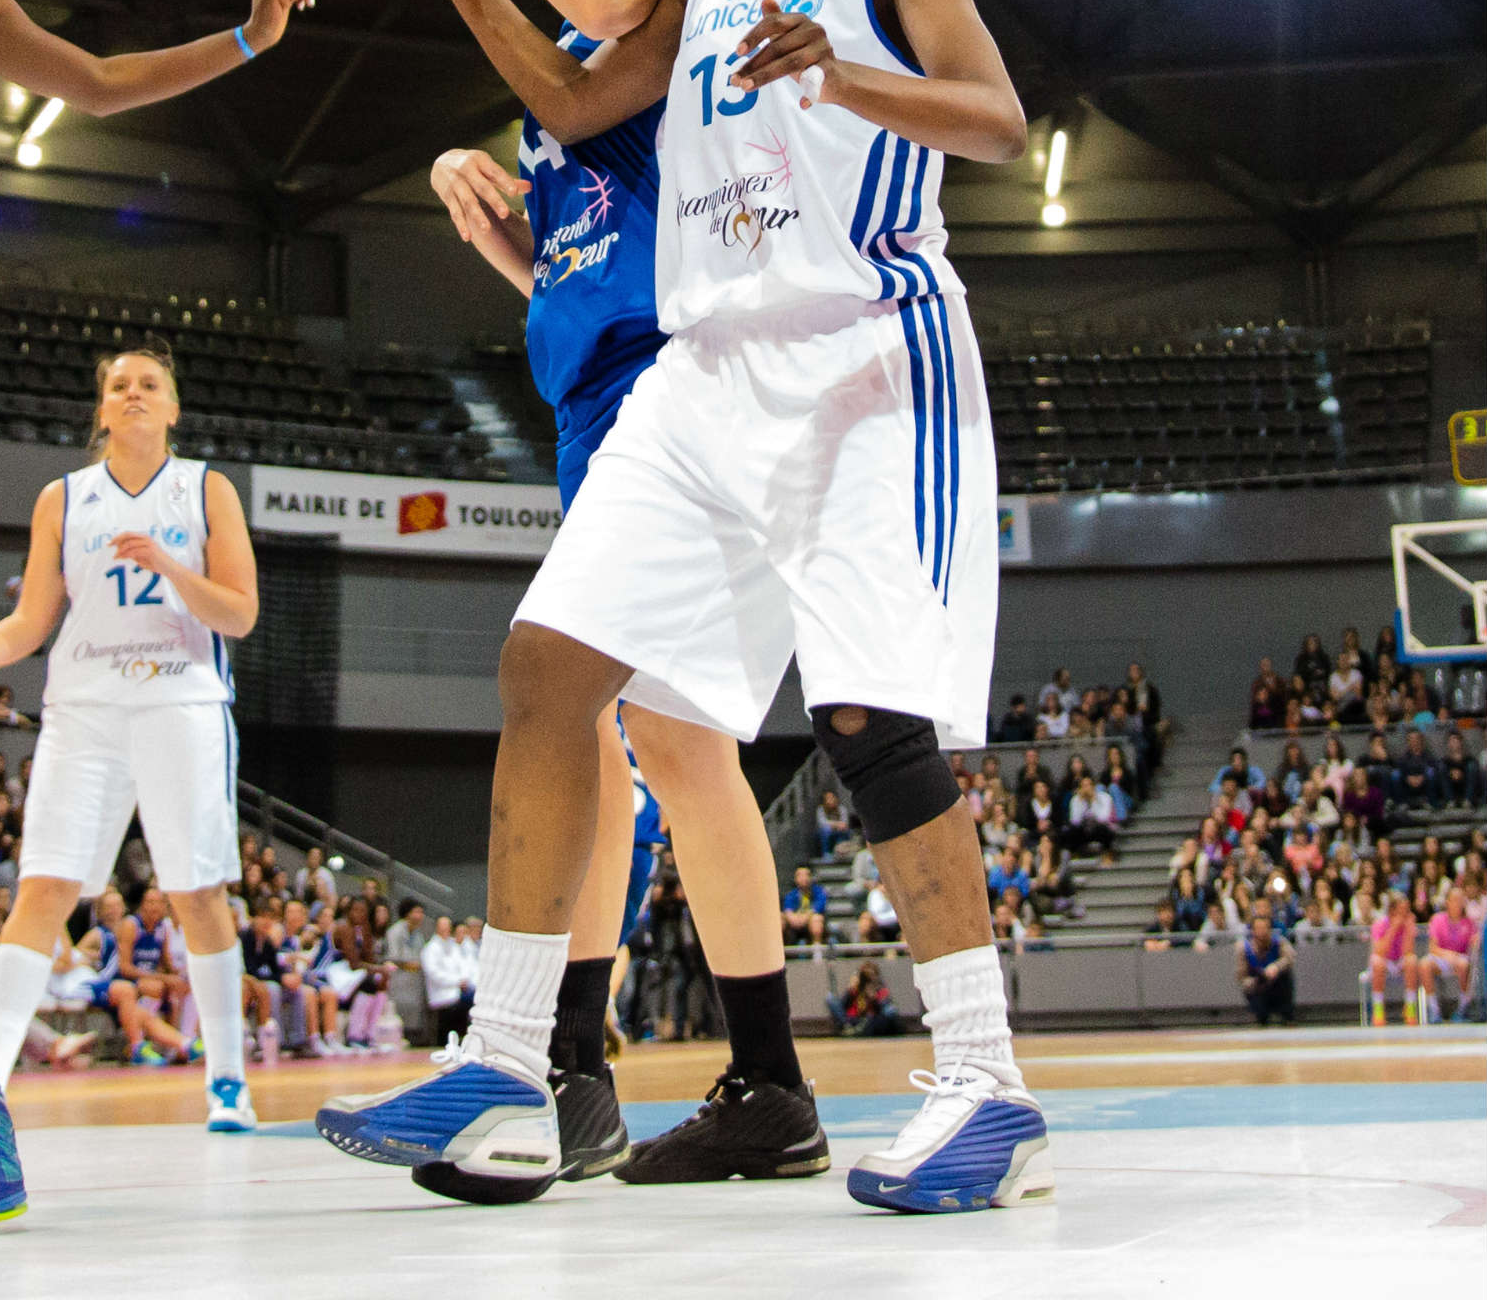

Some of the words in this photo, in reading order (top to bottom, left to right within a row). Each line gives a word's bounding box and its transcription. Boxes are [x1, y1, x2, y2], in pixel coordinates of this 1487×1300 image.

[264, 491, 347, 517] MAIRIE
[357, 499, 386, 519] DE
[105, 564, 163, 607] 12
